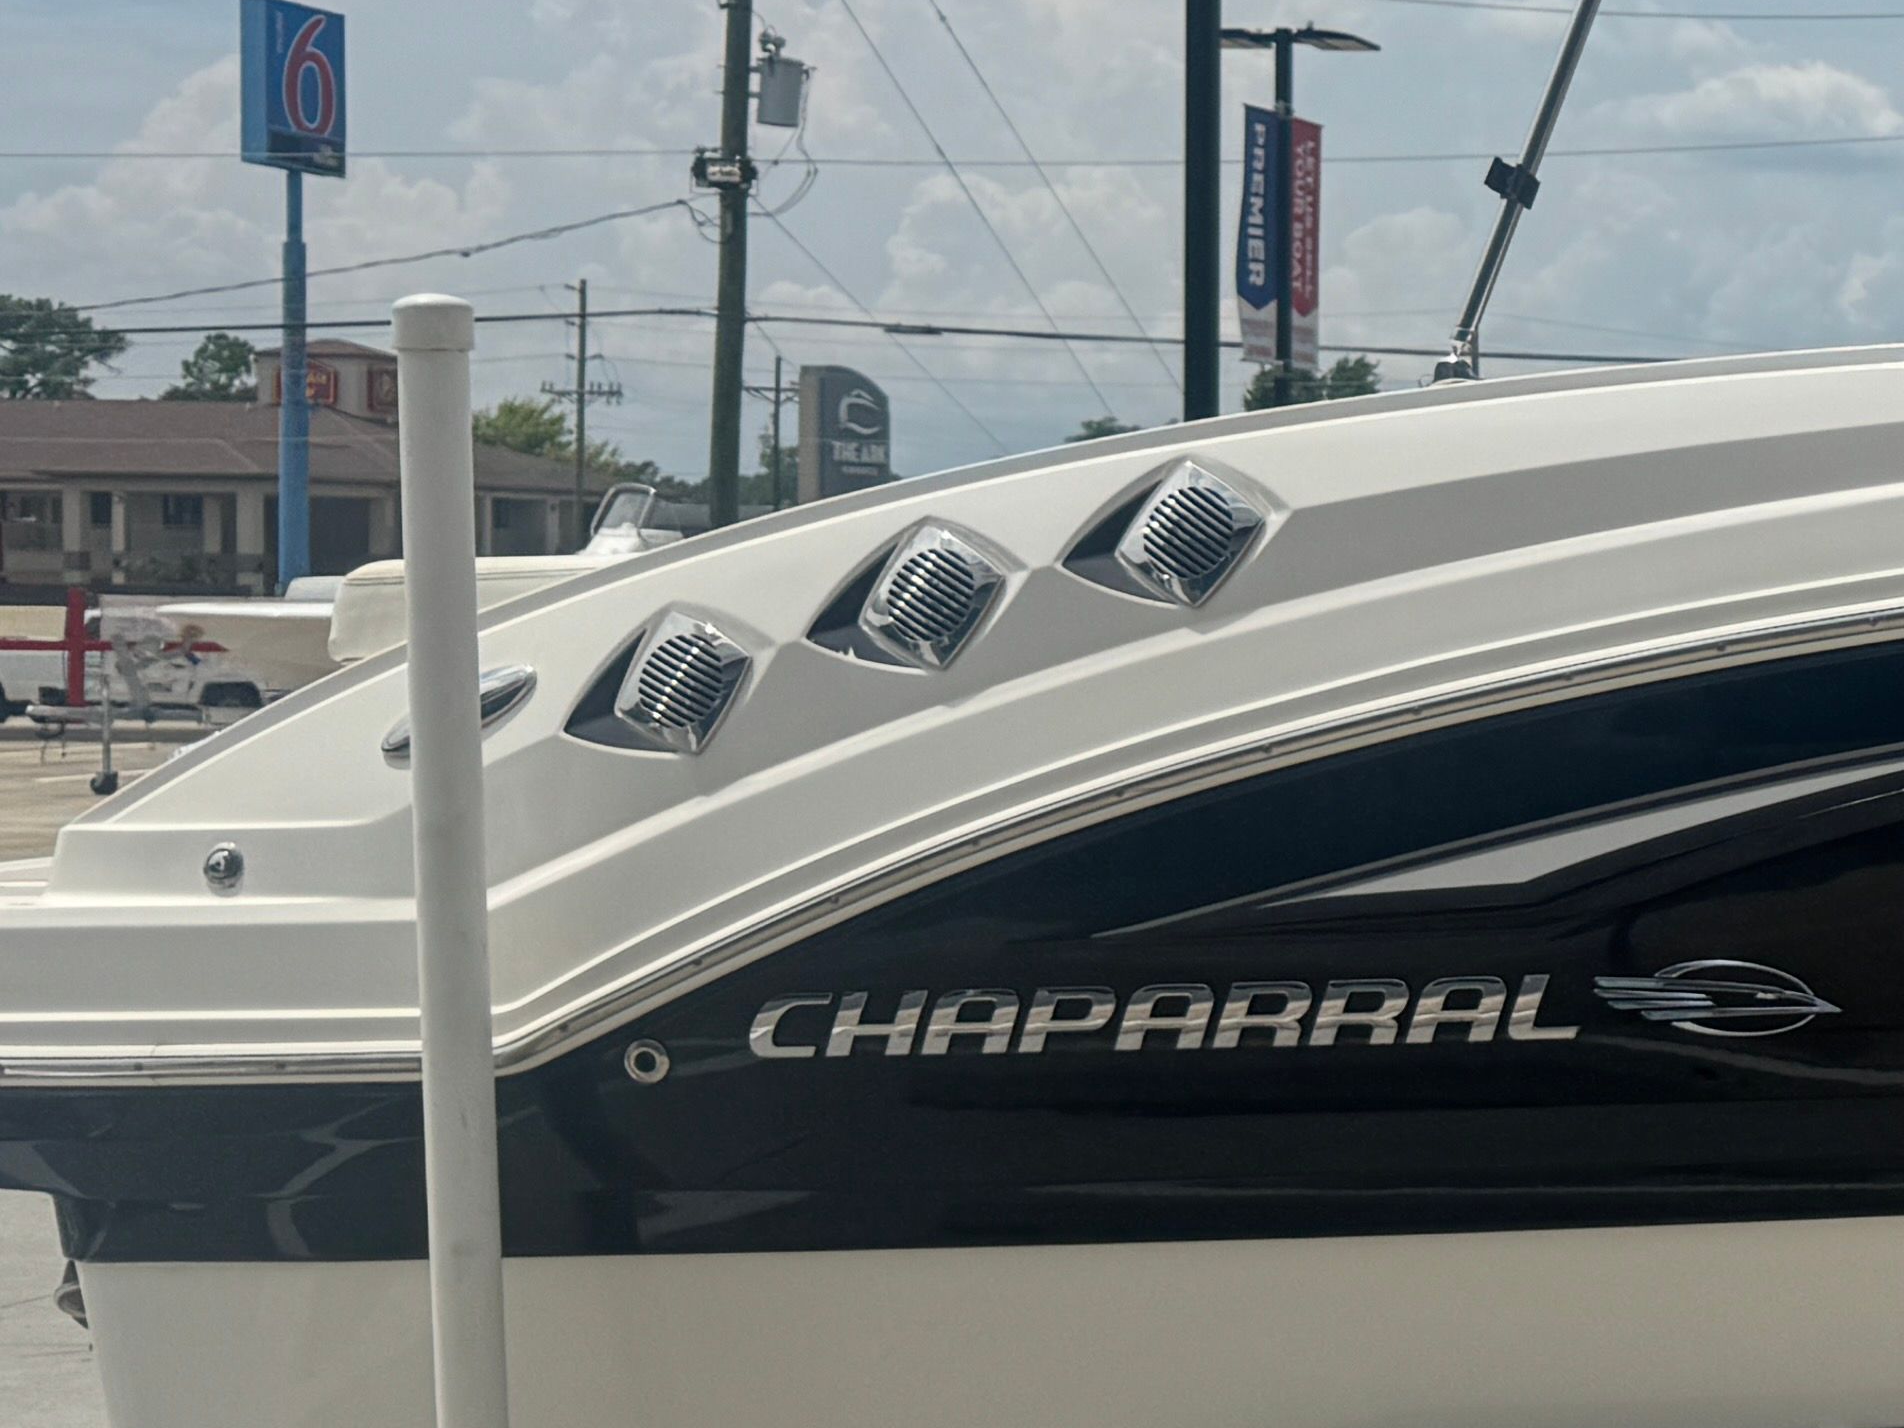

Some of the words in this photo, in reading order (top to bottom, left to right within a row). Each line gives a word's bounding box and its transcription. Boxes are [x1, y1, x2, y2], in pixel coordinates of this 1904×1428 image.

[282, 14, 337, 138] 6
[1247, 122, 1267, 287] PREMIER
[1293, 144, 1306, 215] YOUR
[1292, 221, 1304, 293] BOAT
[748, 974, 1581, 1059] CHAPARRAL
